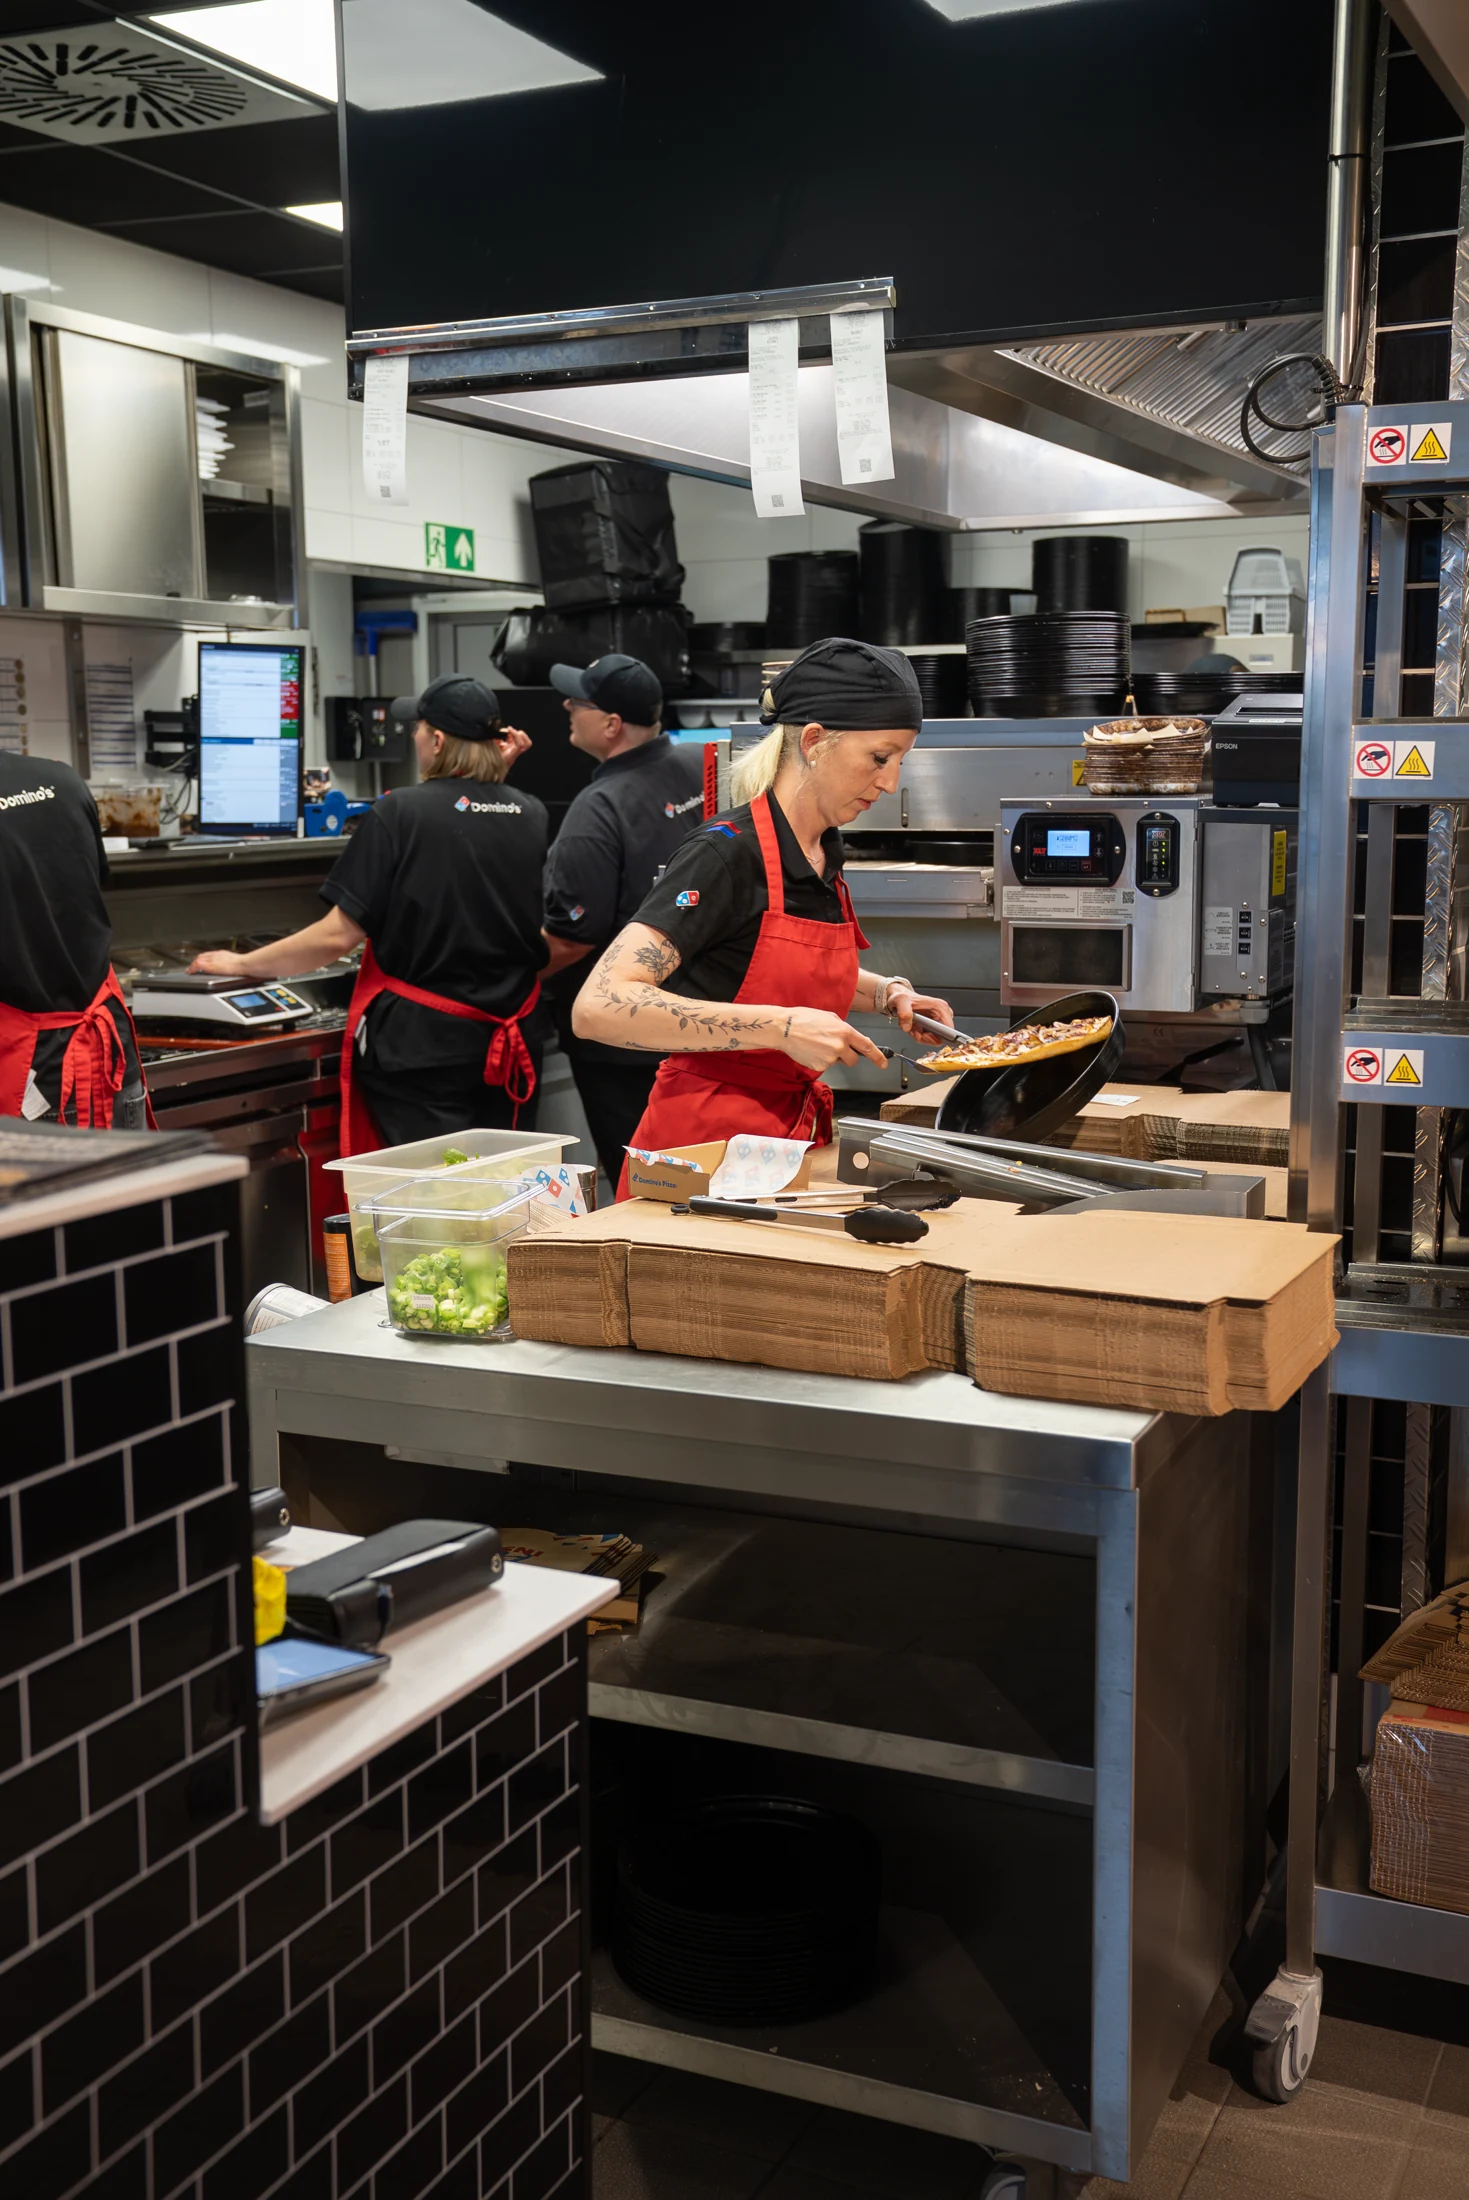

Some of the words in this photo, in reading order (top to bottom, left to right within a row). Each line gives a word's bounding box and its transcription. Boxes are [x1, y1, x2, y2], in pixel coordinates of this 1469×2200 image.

[0, 785, 55, 810] Domino's
[470, 801, 522, 814] Domino's
[638, 1176, 662, 1187] Domino's
